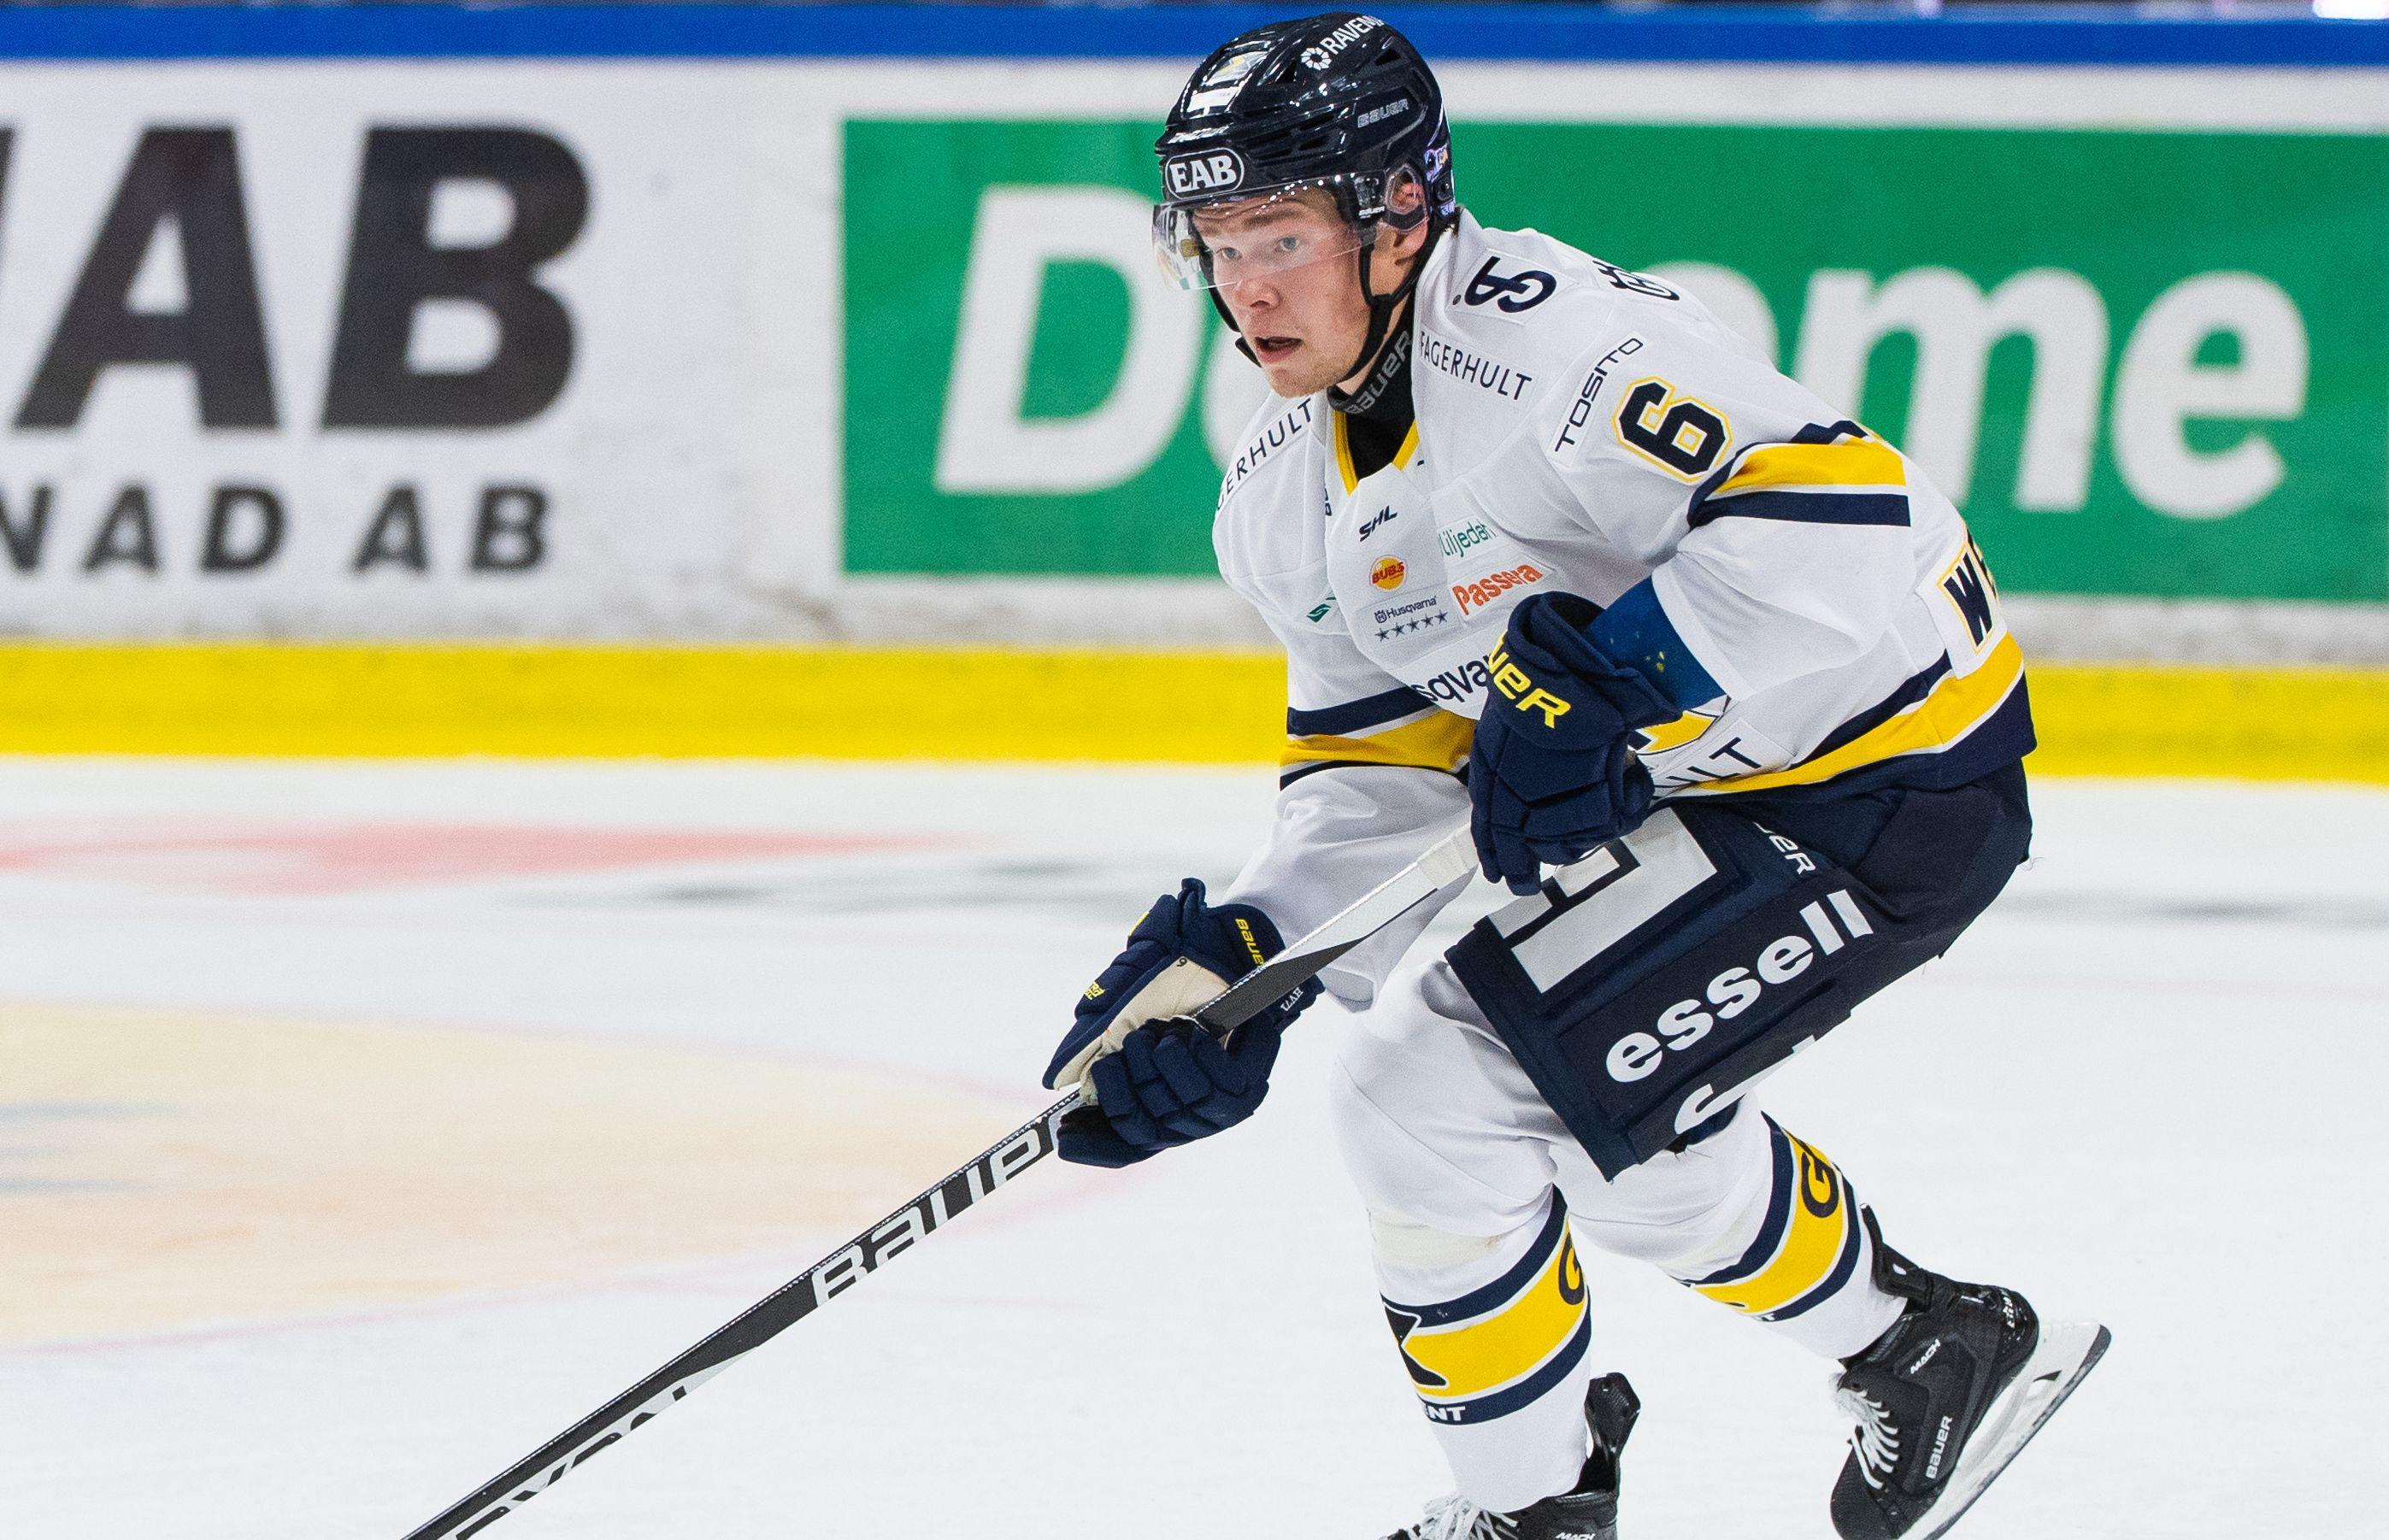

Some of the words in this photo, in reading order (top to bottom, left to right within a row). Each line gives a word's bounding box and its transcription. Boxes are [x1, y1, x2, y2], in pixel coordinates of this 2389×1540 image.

[1169, 155, 1238, 193] EAB
[0, 126, 591, 432] AB
[936, 185, 2311, 518] Dme
[1419, 331, 1533, 401] FAGERHULT
[1555, 338, 1644, 452] TOSITO
[1614, 378, 1732, 481] 6
[350, 484, 549, 573] AB
[1359, 505, 1398, 543] SHL
[1372, 561, 1405, 585] BUBS
[1451, 564, 1544, 616] Passera
[1386, 595, 1437, 620] Husqvarna
[1410, 655, 1491, 703] sqva
[1606, 889, 1874, 1083] essell
[1910, 1338, 1942, 1375] MACH
